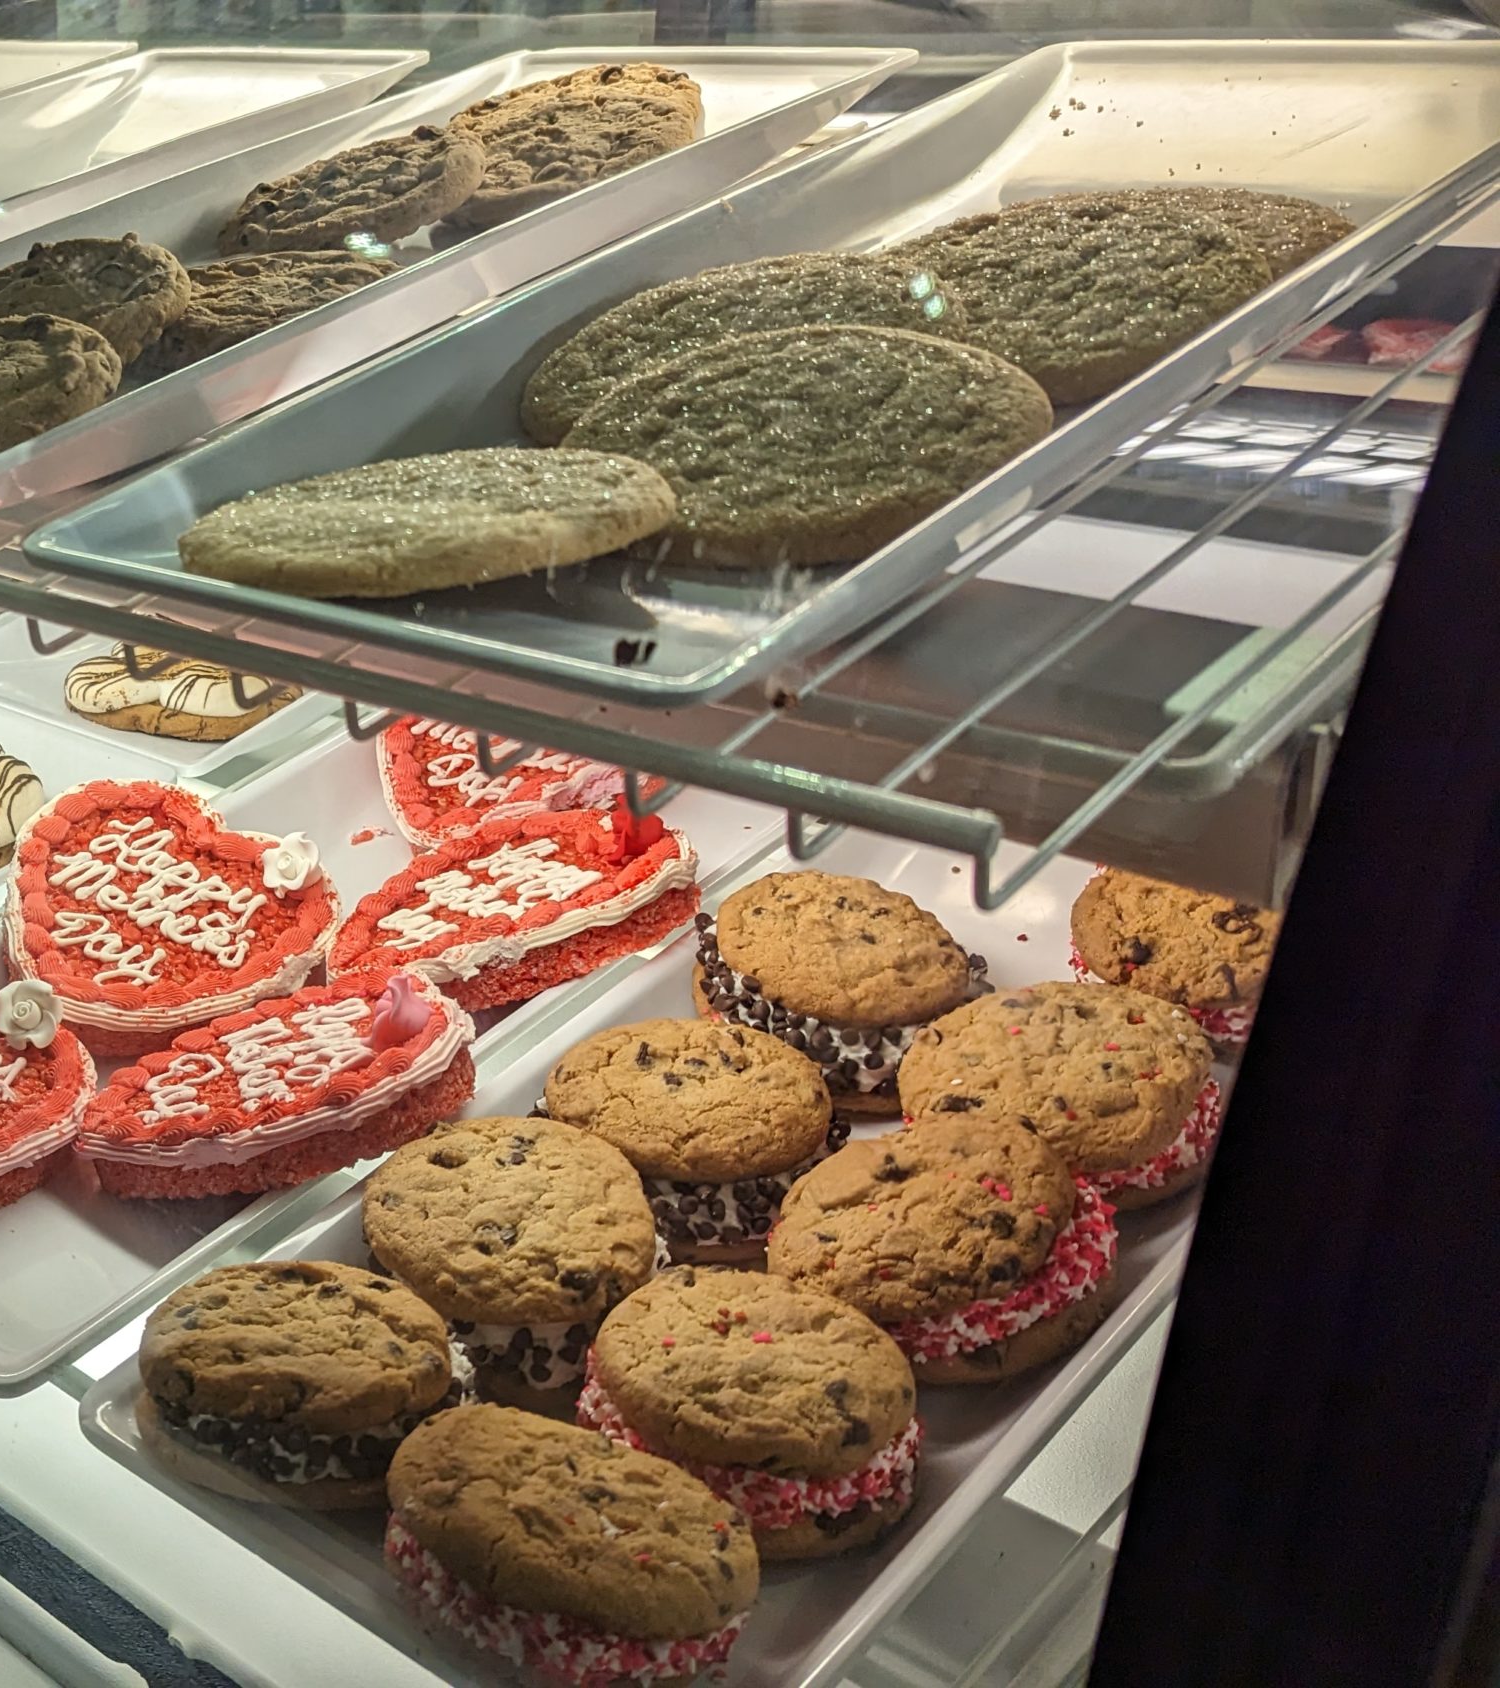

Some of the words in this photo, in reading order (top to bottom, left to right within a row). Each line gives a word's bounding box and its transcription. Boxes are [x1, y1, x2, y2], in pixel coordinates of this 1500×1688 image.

[89, 817, 268, 932] Happy
[50, 912, 167, 986] Day
[135, 1053, 224, 1125] Day
